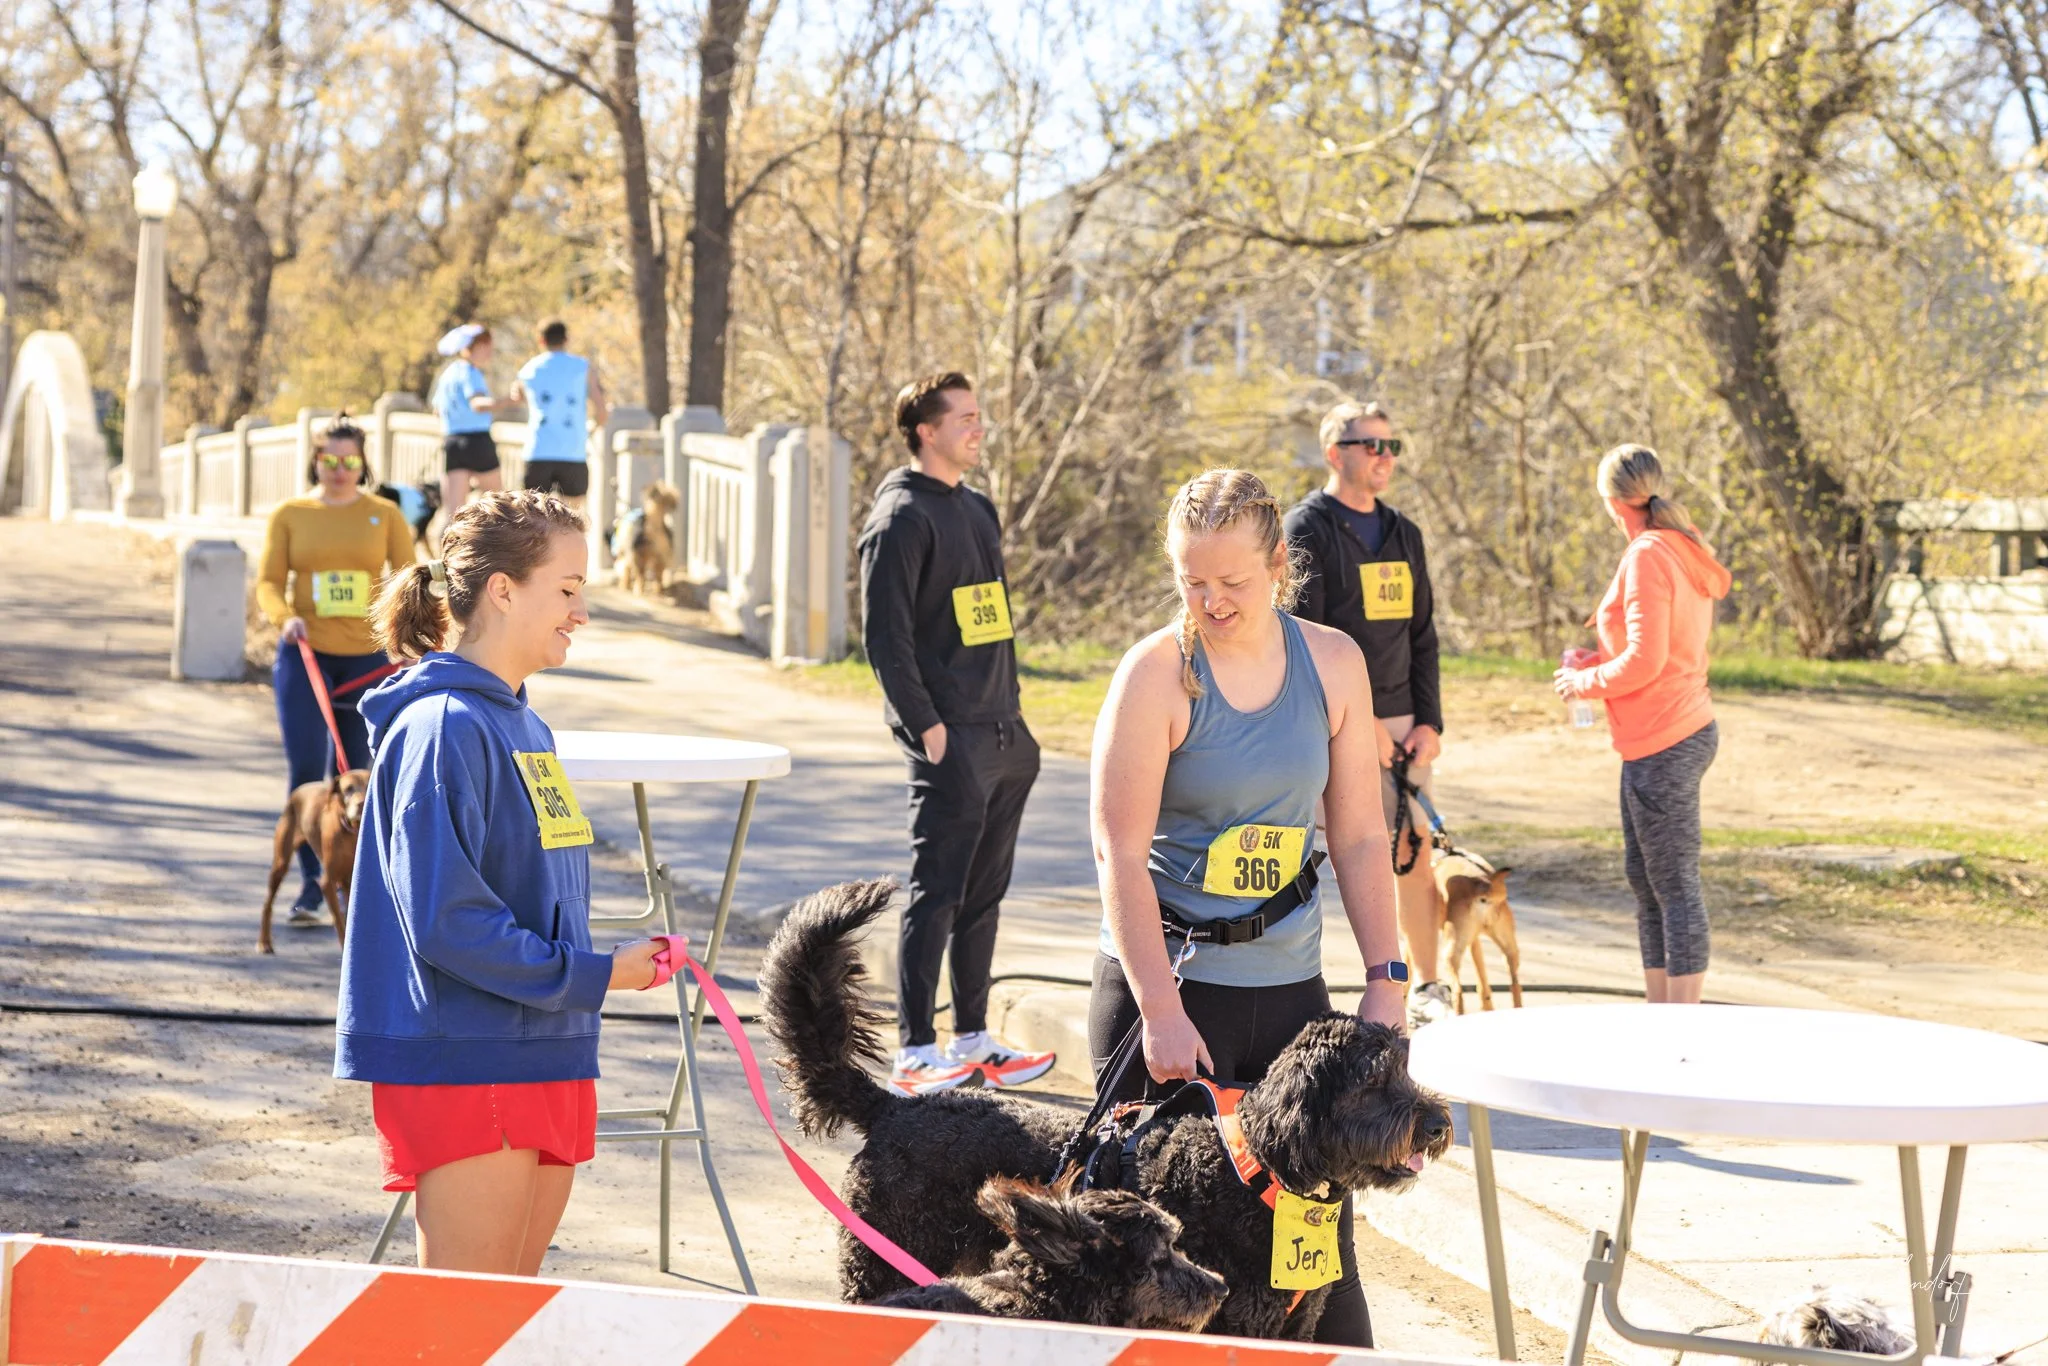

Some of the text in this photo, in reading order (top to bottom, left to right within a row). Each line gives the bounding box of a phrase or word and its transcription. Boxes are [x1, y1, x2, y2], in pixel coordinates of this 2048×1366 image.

[330, 587, 353, 601] 139
[1378, 583, 1403, 602] 400
[972, 604, 998, 626] 399
[536, 758, 552, 778] 5K
[536, 786, 572, 819] 305
[1263, 831, 1284, 850] 5K
[1233, 856, 1281, 892] 366
